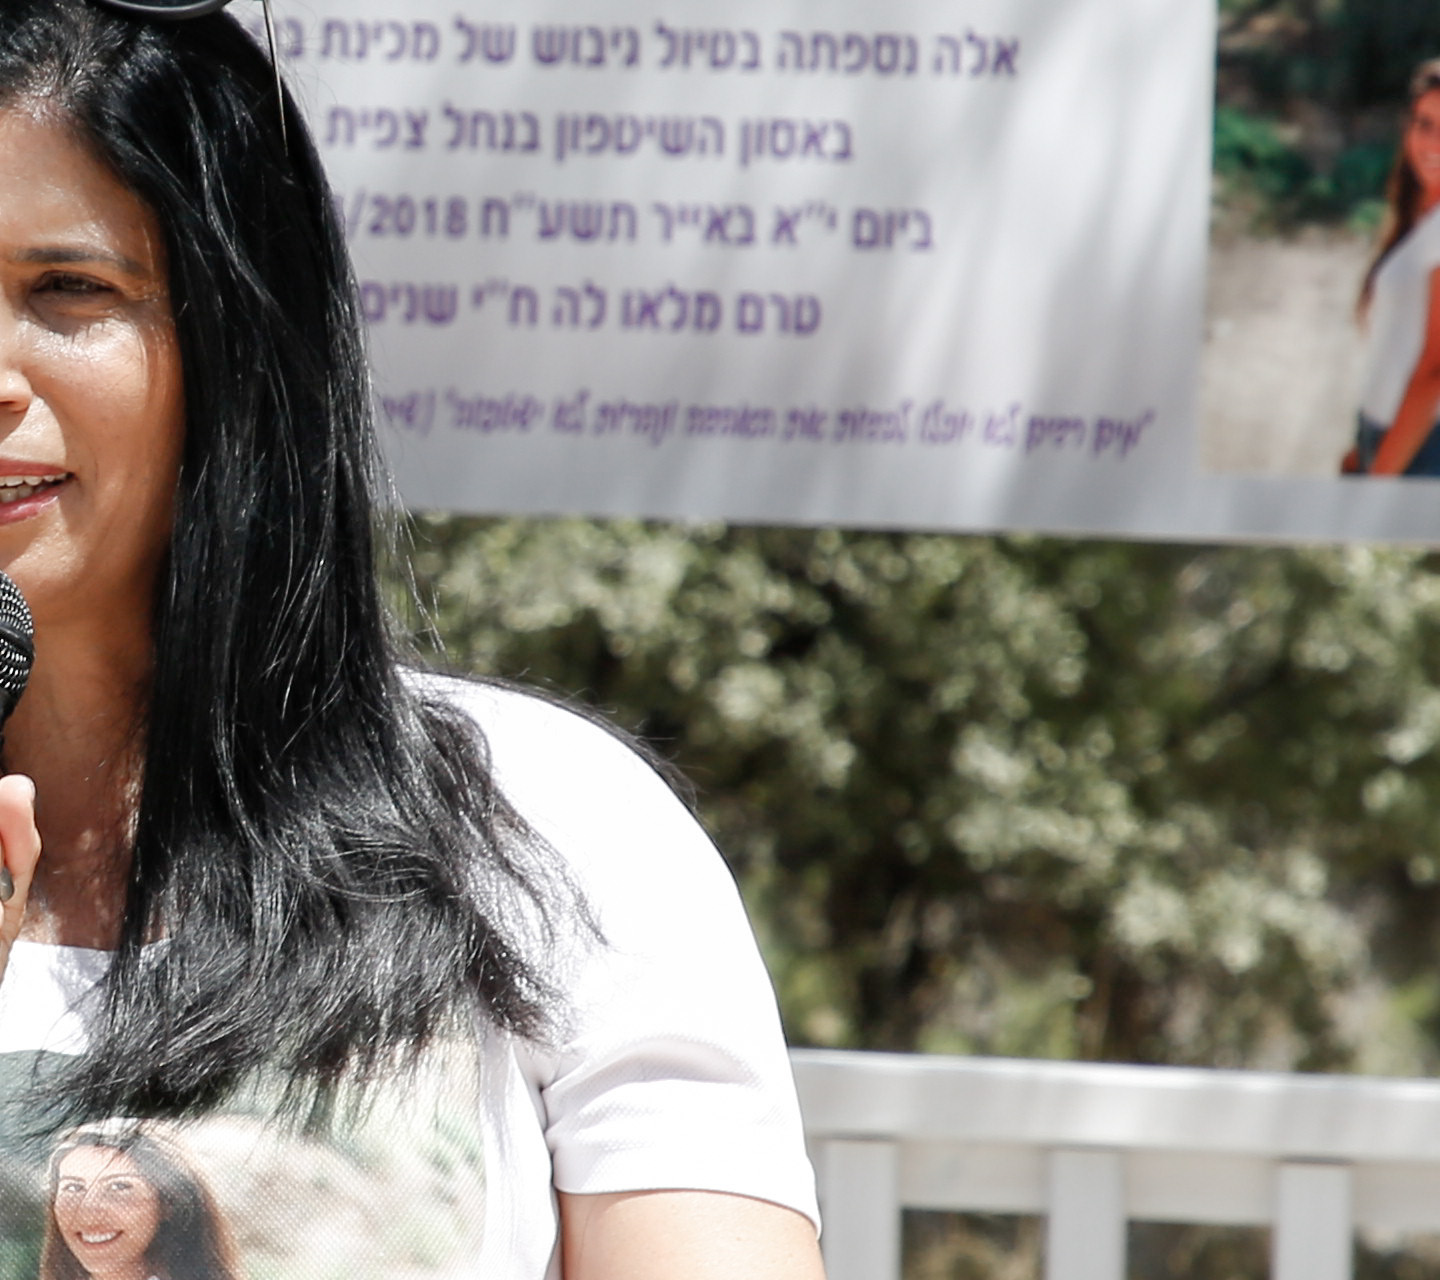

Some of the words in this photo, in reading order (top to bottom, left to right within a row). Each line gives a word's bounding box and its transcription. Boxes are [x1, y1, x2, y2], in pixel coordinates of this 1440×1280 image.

[324, 18, 442, 63] מכינת
[452, 14, 516, 66] של
[532, 26, 641, 69] גיבוש
[652, 19, 763, 72] בטיול
[776, 30, 919, 77] נספתה
[933, 30, 1021, 78] אלה
[325, 105, 429, 152] צפית
[443, 101, 542, 155] בנחל
[553, 113, 725, 165] השיטפון
[738, 117, 855, 171] באסון
[652, 202, 757, 248] באייר
[771, 203, 837, 246] י"א
[850, 207, 934, 253] ביום
[360, 281, 458, 327] שנים
[552, 279, 608, 330] לה
[620, 284, 723, 334] מלאו
[734, 292, 822, 338] טרם
